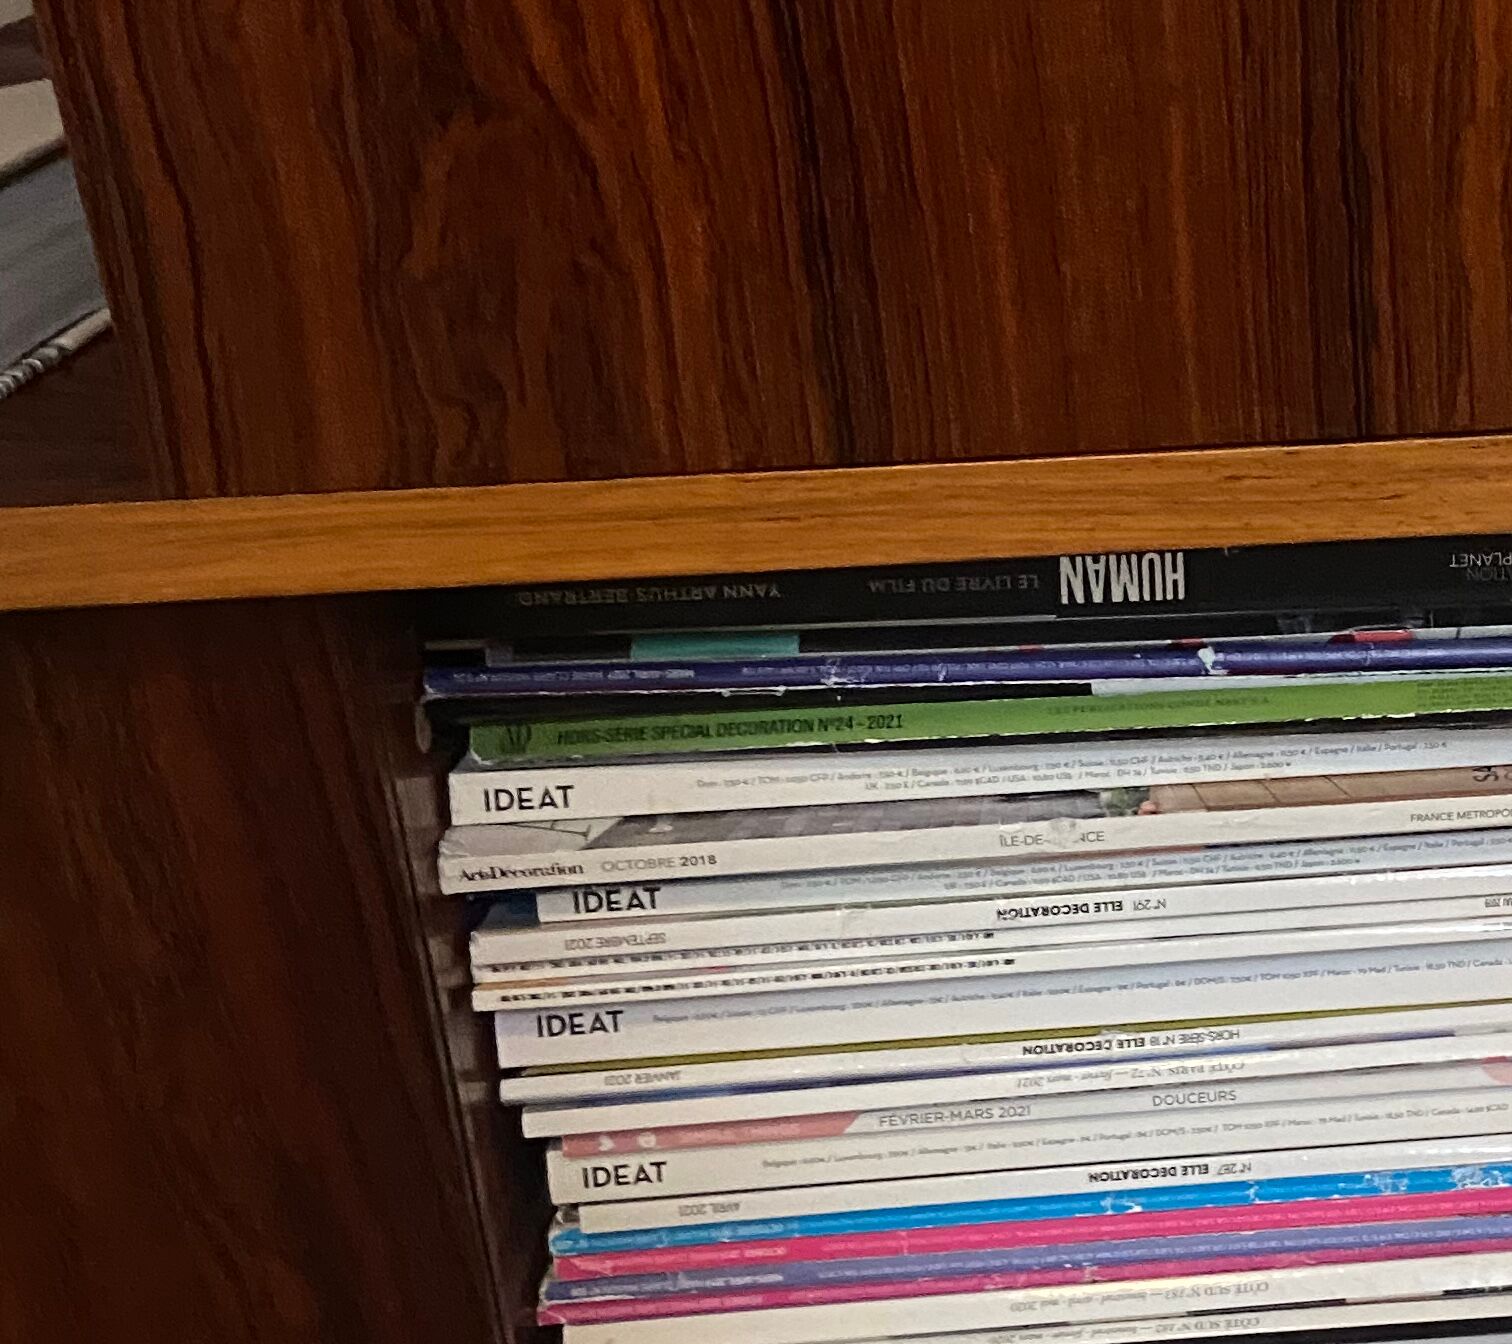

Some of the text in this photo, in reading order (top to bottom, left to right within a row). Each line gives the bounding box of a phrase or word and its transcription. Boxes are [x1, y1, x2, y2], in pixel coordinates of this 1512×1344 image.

[865, 573, 1039, 595] LE LIVRE DU FILM
[1058, 551, 1186, 605] HUMAN
[723, 583, 782, 600] YANN
[867, 713, 903, 729] 2021
[482, 784, 575, 813] IDEAT
[1410, 811, 1455, 823] FRANCE
[601, 857, 676, 873] OCTOBRE
[679, 854, 718, 867] 2018
[572, 887, 662, 914] IDEAT
[1094, 899, 1124, 913] ELLE
[996, 902, 1091, 921] DECORATION
[594, 932, 667, 949] SEPTEMBRE
[536, 1009, 624, 1038] IDEAT
[1021, 1039, 1112, 1057] DECORATION
[1116, 1036, 1146, 1050] ELLE
[634, 1070, 682, 1084] JANVIER
[1151, 1089, 1238, 1107] DOUCEURS
[879, 1105, 1032, 1128] FÉVRIER-MARS 2021
[582, 1161, 668, 1189] IDEAT
[1088, 1166, 1178, 1183] DECORATION
[1178, 1163, 1210, 1177] ELLE
[713, 1202, 741, 1215] AVRIL
[1203, 1284, 1231, 1297] SUD
[1193, 1319, 1222, 1332] SUD
